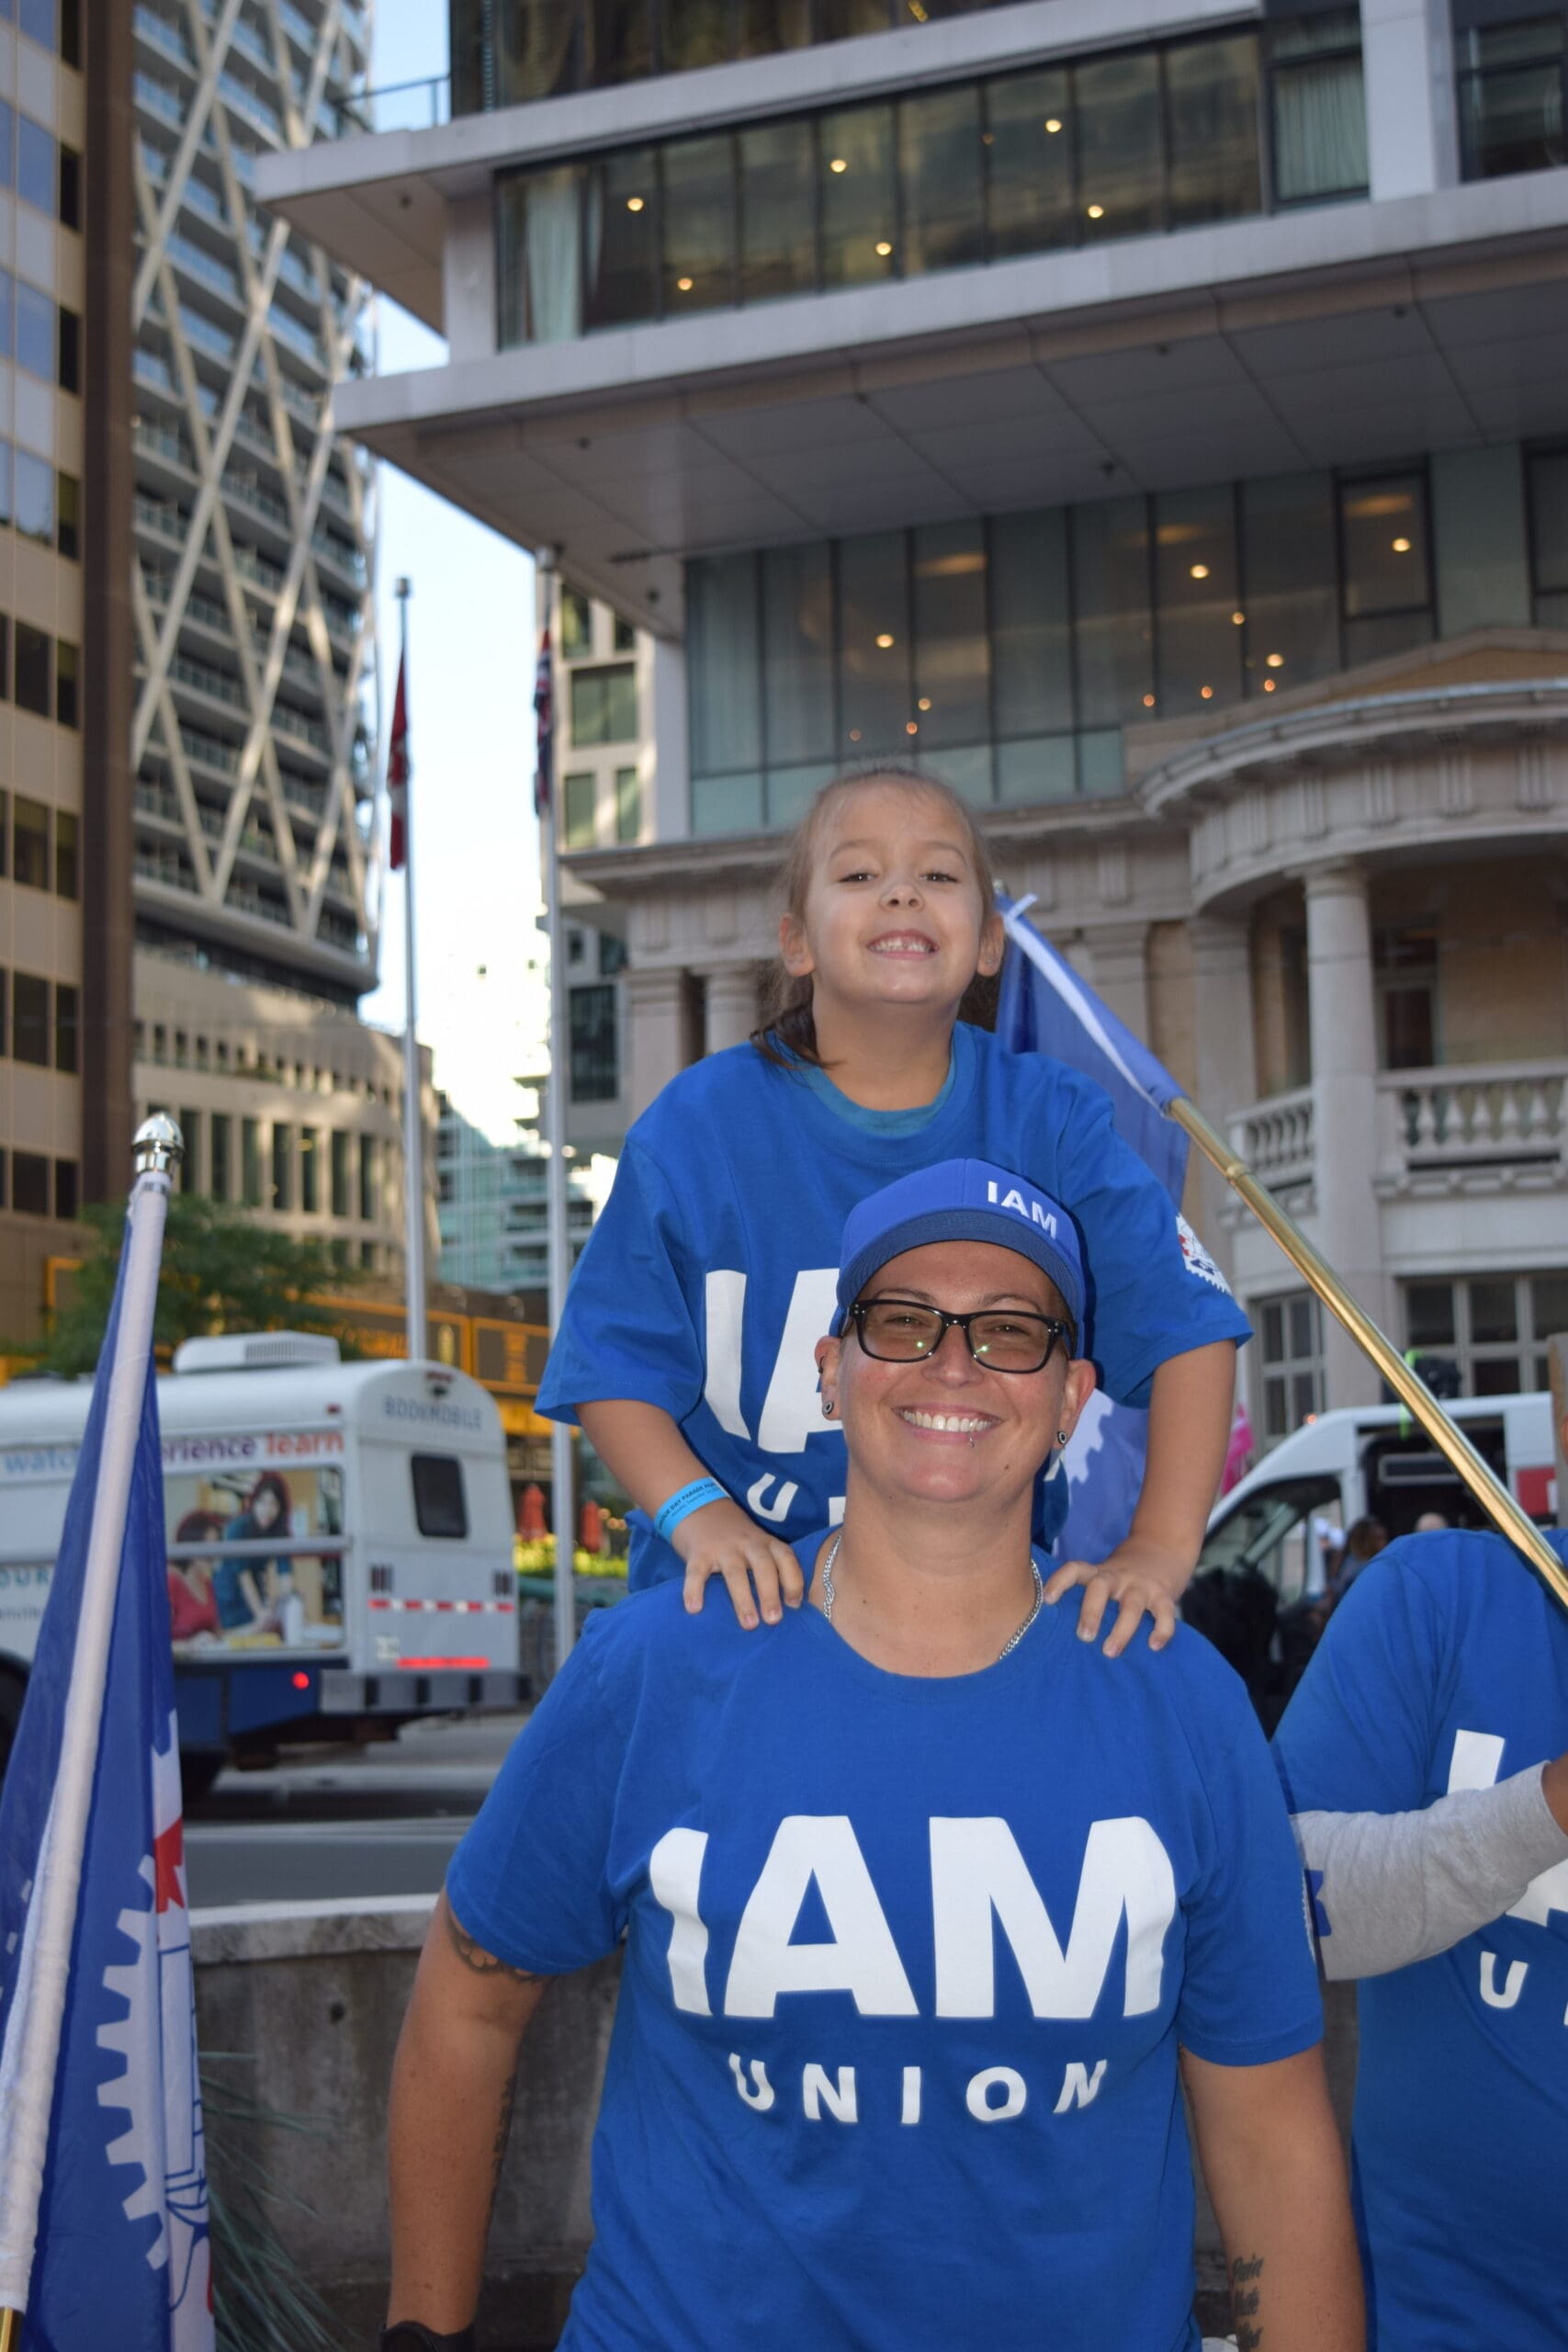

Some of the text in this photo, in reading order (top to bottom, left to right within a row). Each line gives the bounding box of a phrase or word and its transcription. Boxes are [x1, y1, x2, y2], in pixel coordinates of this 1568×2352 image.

[987, 1181, 1057, 1239] IAM
[704, 1268, 843, 1453] IA
[383, 1395, 482, 1430] BOOKMOBILE
[6, 1449, 78, 1473] watc
[266, 1430, 345, 1456] learn
[649, 1815, 1177, 2019] IAM
[728, 2052, 1108, 2124] UNION
